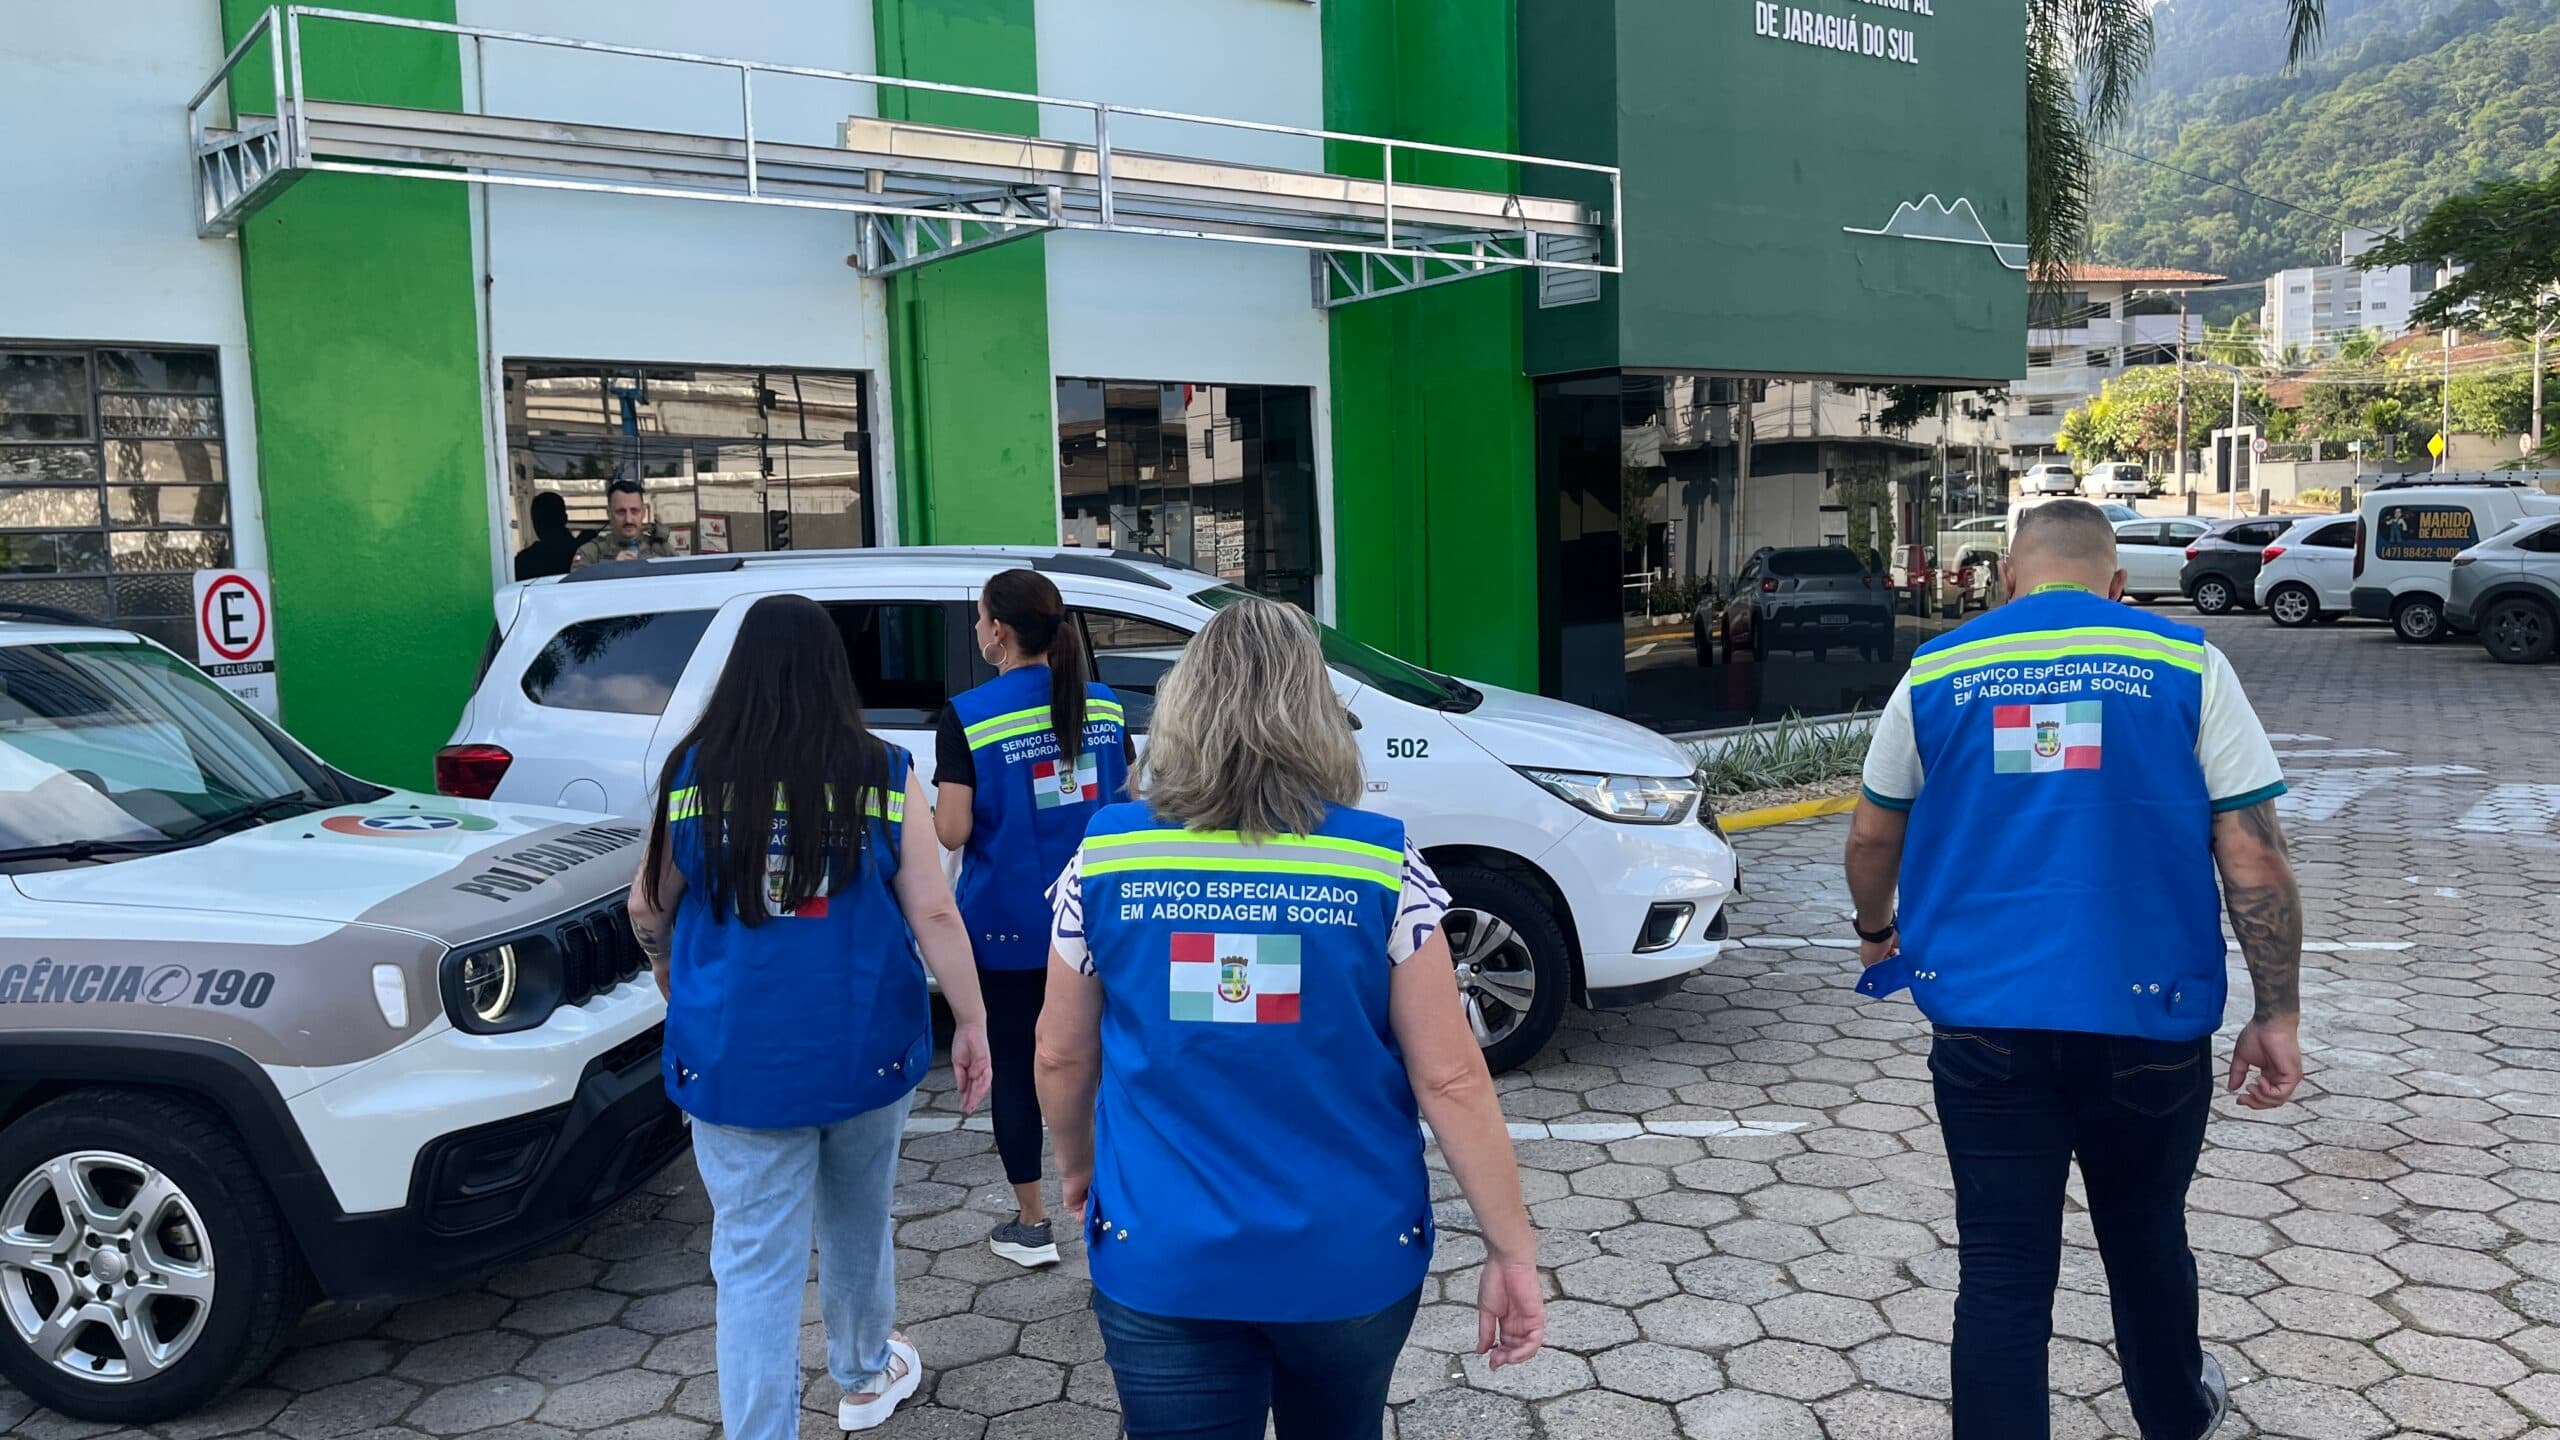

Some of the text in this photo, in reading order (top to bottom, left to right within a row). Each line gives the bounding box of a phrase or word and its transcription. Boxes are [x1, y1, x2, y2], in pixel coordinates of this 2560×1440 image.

[1755, 1, 1779, 37] DE
[1782, 7, 1859, 53] JARAGUÁ
[1863, 22, 1885, 58] DO
[1888, 28, 1919, 64] SUL
[2420, 511, 2472, 528] MARIDO
[2418, 528, 2470, 539] DE ALUGUEL
[220, 591, 249, 645] E
[213, 662, 264, 676] EXCLUSIVO
[1953, 661, 2154, 690] SERVIÇO ESPECIALIZADO
[1978, 678, 2082, 699] ABORDAGEM
[2090, 677, 2152, 699] SOCIAL
[1001, 735, 1042, 753] SERVIÇO
[1020, 744, 1062, 760] ABORDA
[1386, 737, 1429, 758] 502
[452, 843, 594, 903] POLÍCIA
[1120, 880, 1358, 905] SERVIÇO ESPECIALIZADO
[1120, 903, 1358, 926] EM ABORDAGEM SOCIAL
[0, 957, 275, 1009] GÊNCIA 190
